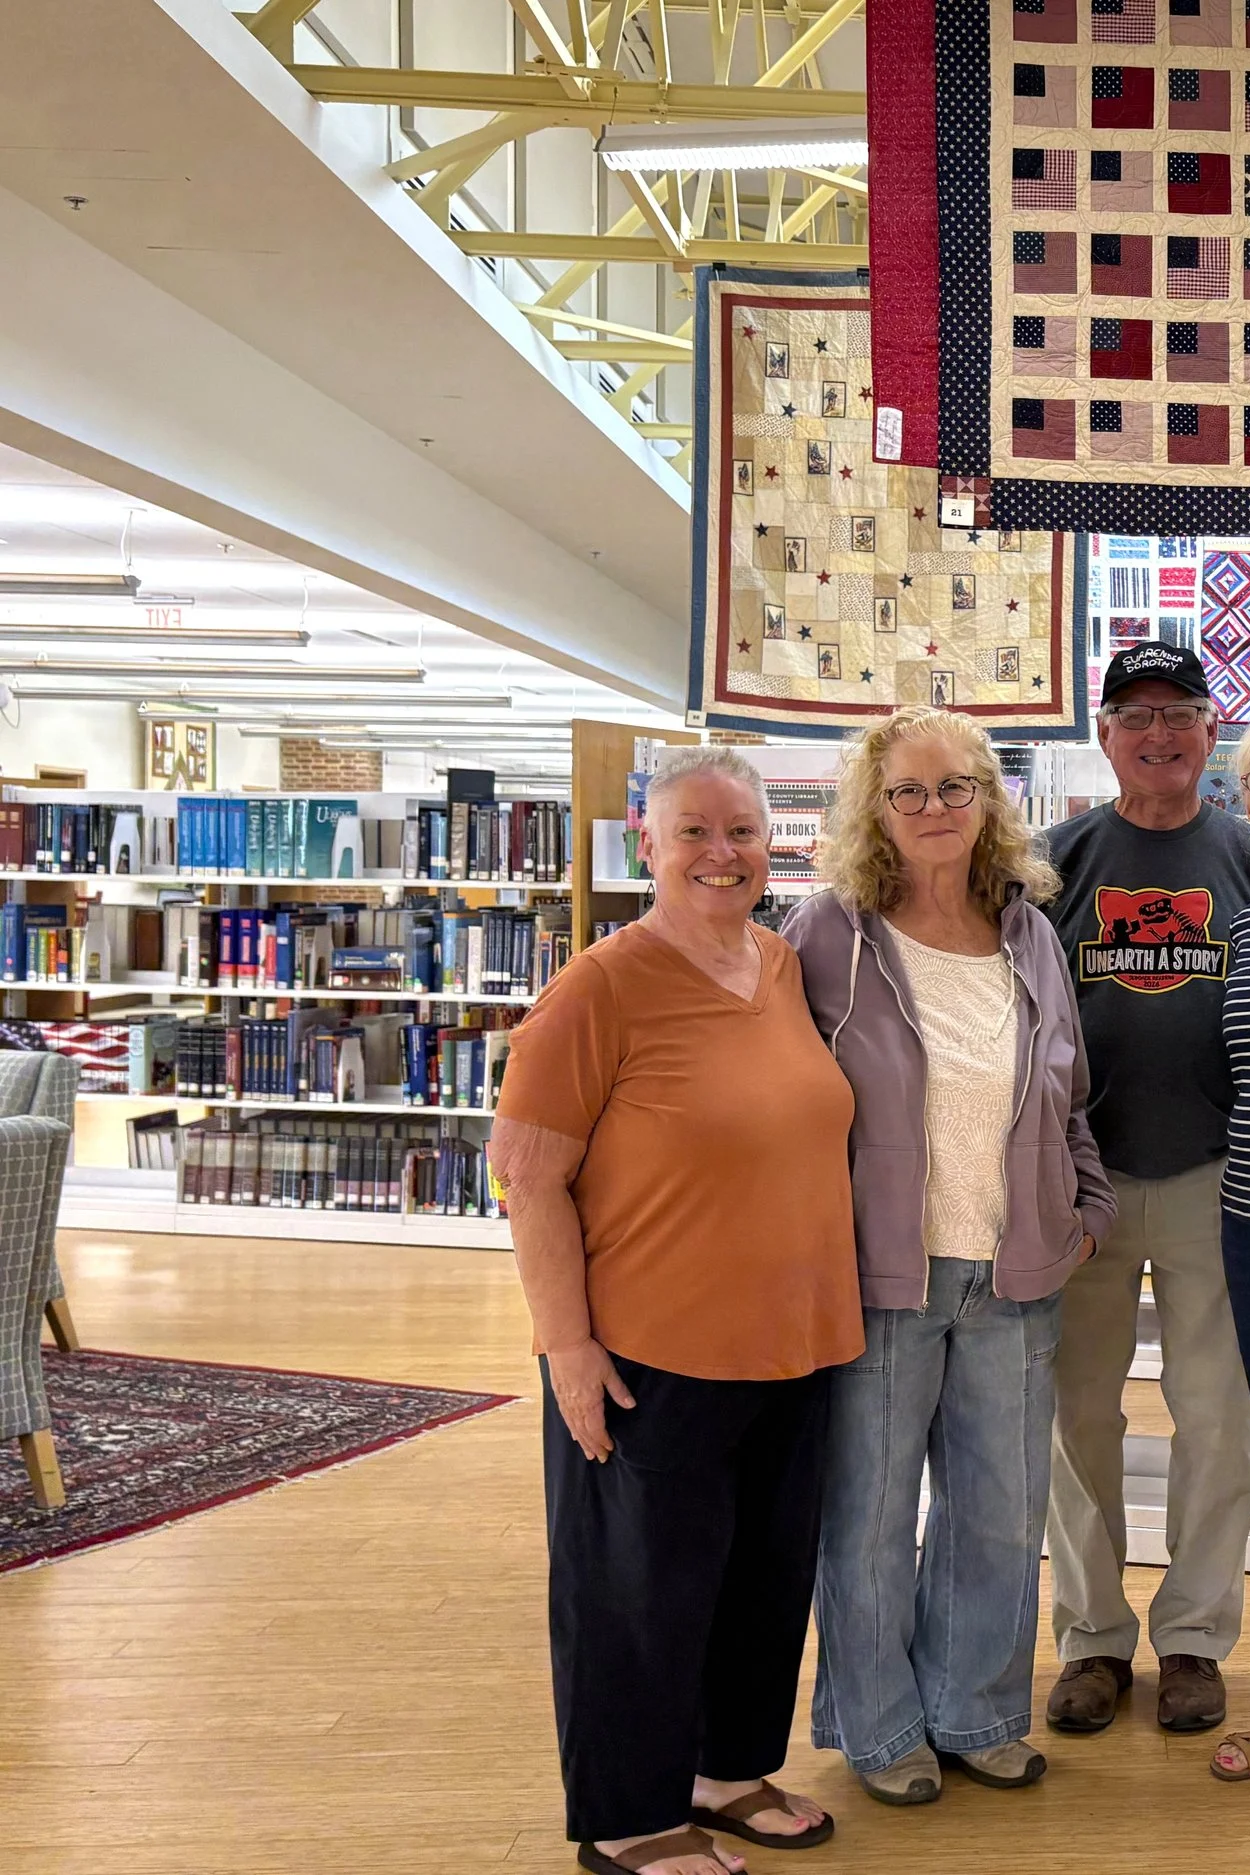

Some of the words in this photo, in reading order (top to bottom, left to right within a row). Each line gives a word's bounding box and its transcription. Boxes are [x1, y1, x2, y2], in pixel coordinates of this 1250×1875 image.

[951, 509, 962, 517] 21
[1122, 648, 1184, 667] SURRENDER
[1126, 657, 1180, 674] DOROTHY
[786, 823, 817, 836] BOOKS
[1086, 948, 1154, 973] UNEARTH
[1158, 947, 1169, 971] A
[1173, 946, 1222, 973] STORY
